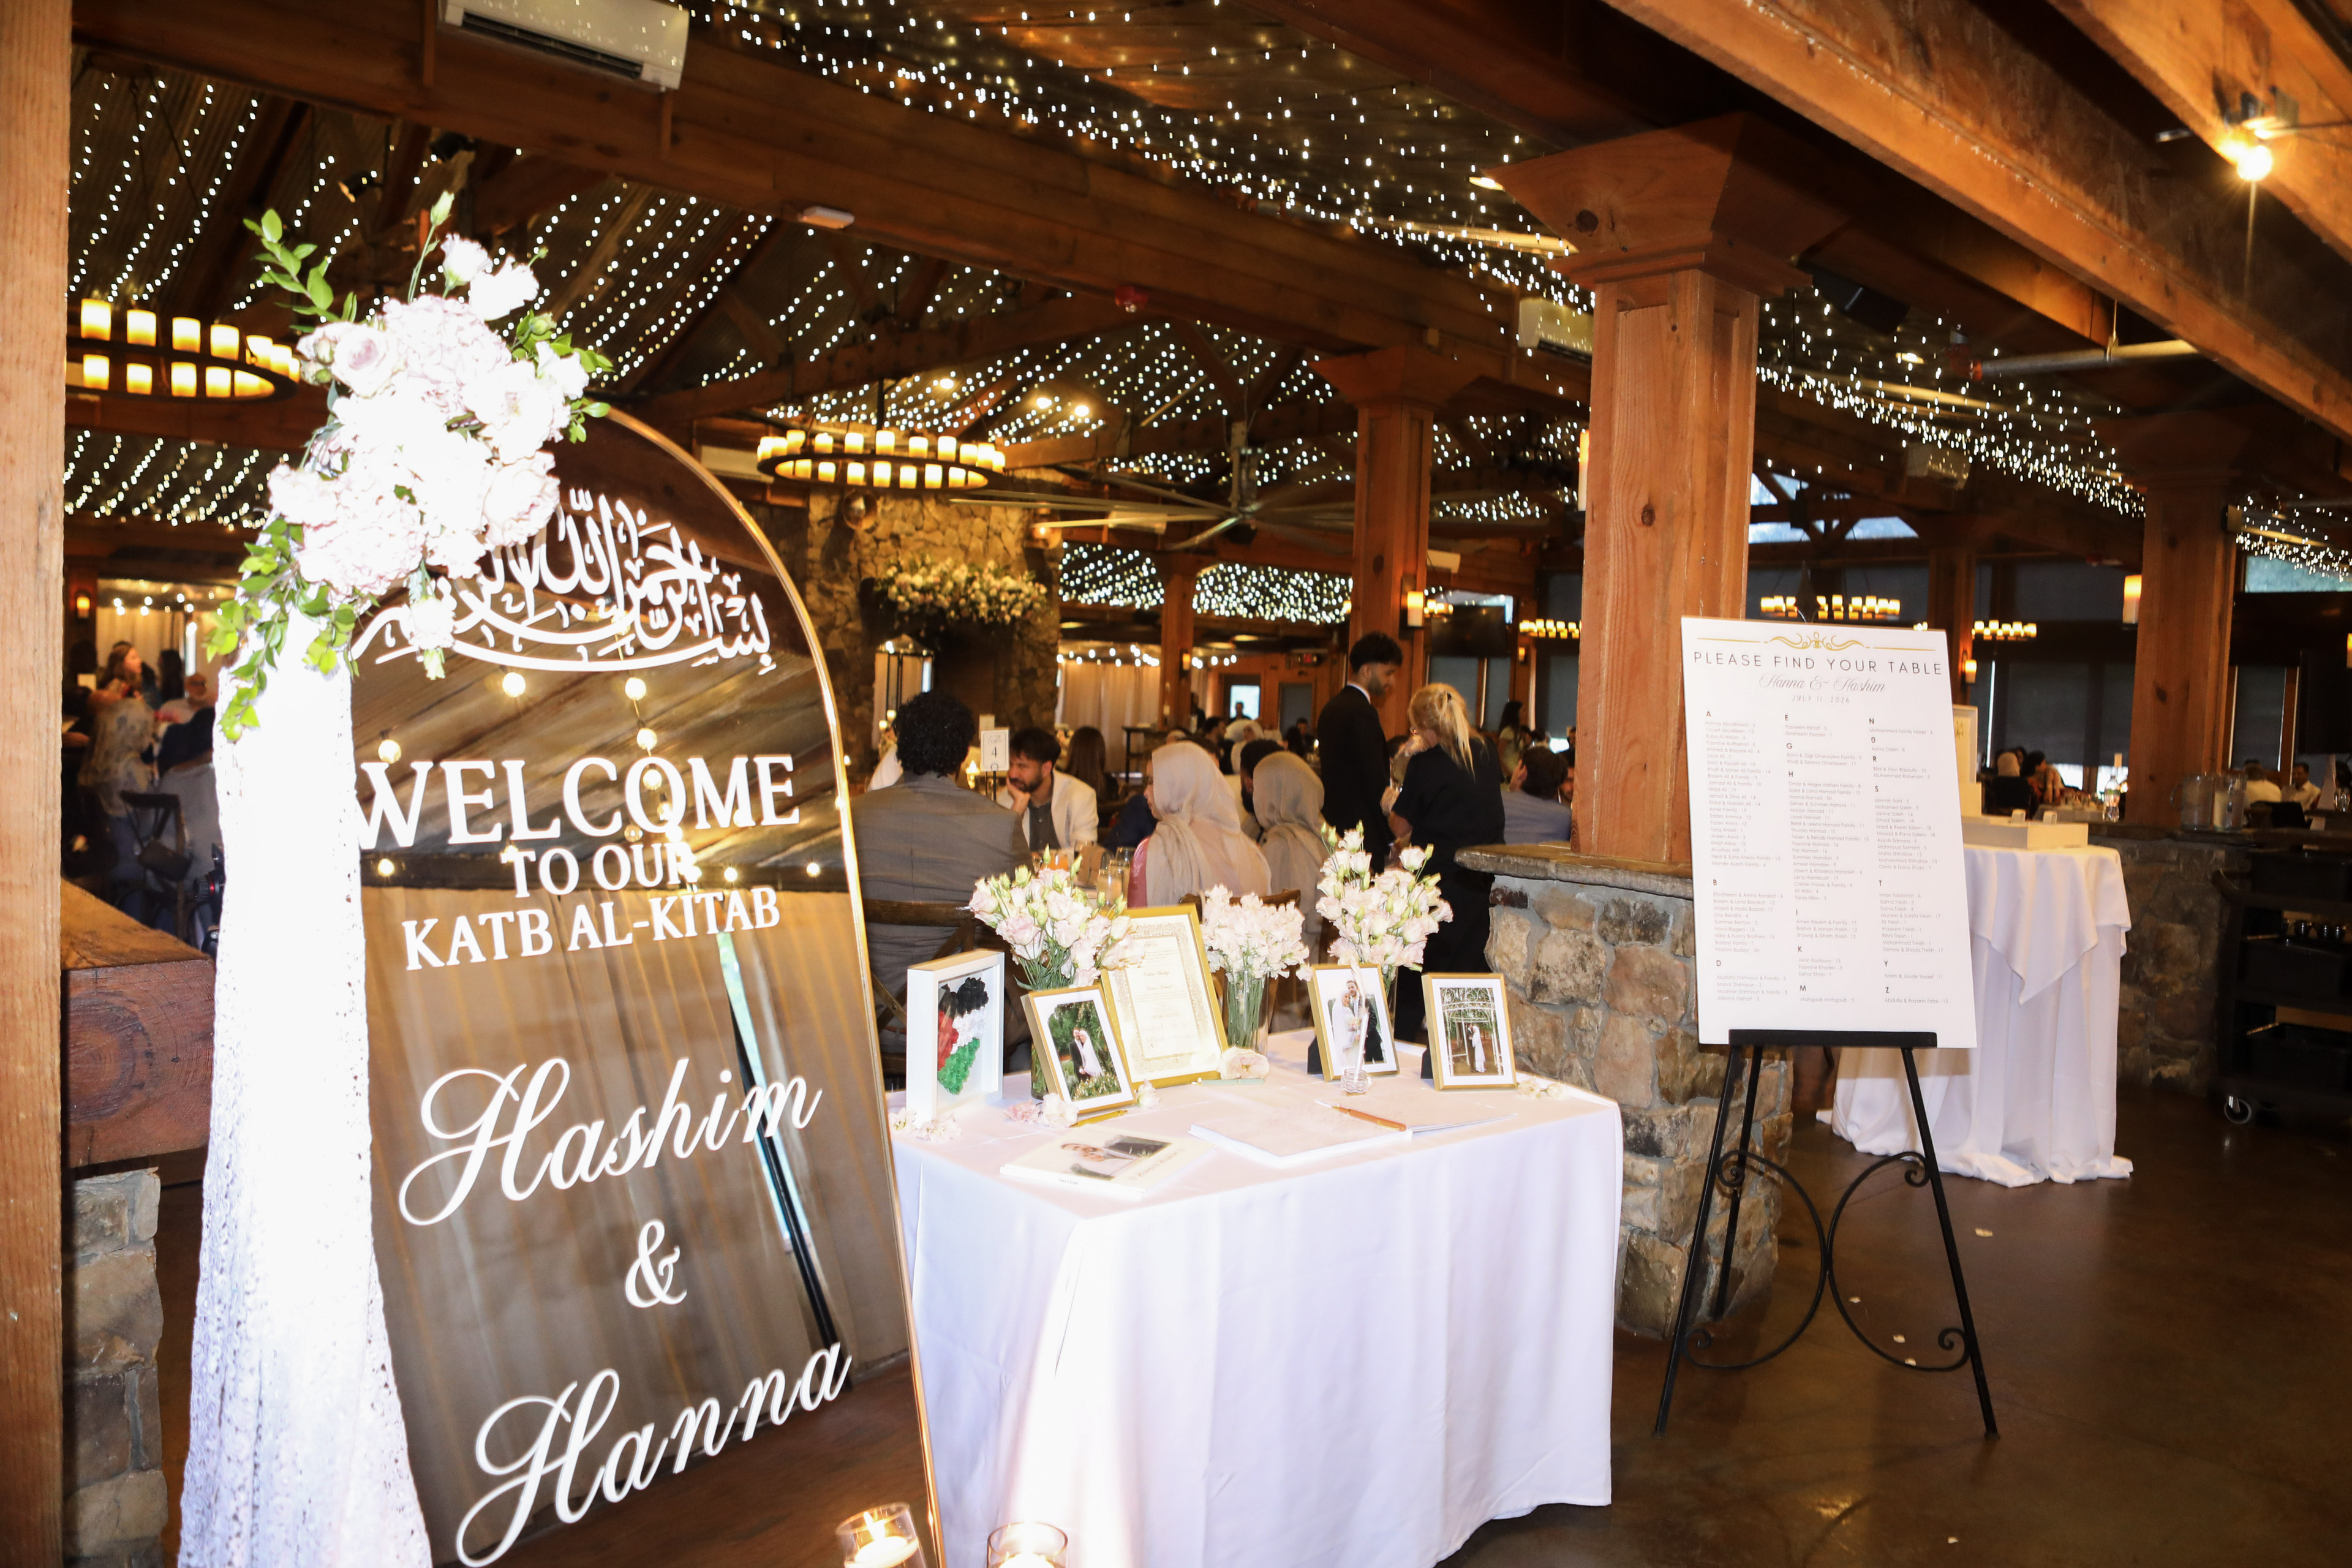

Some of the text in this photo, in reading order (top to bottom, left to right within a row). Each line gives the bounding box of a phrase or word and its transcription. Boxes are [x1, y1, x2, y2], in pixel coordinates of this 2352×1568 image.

[1694, 652, 1941, 675] PLEASE FIND YOUR TABLE
[1759, 673, 1886, 694] Hanna & Hashim
[991, 746, 998, 758] 4
[356, 754, 801, 851] WELCOME
[502, 843, 698, 898] TO OUR
[401, 886, 780, 971] KATB AL-KITAB
[399, 1057, 823, 1226] Hashim
[625, 1219, 687, 1308] &
[456, 1341, 852, 1567] Hanna
